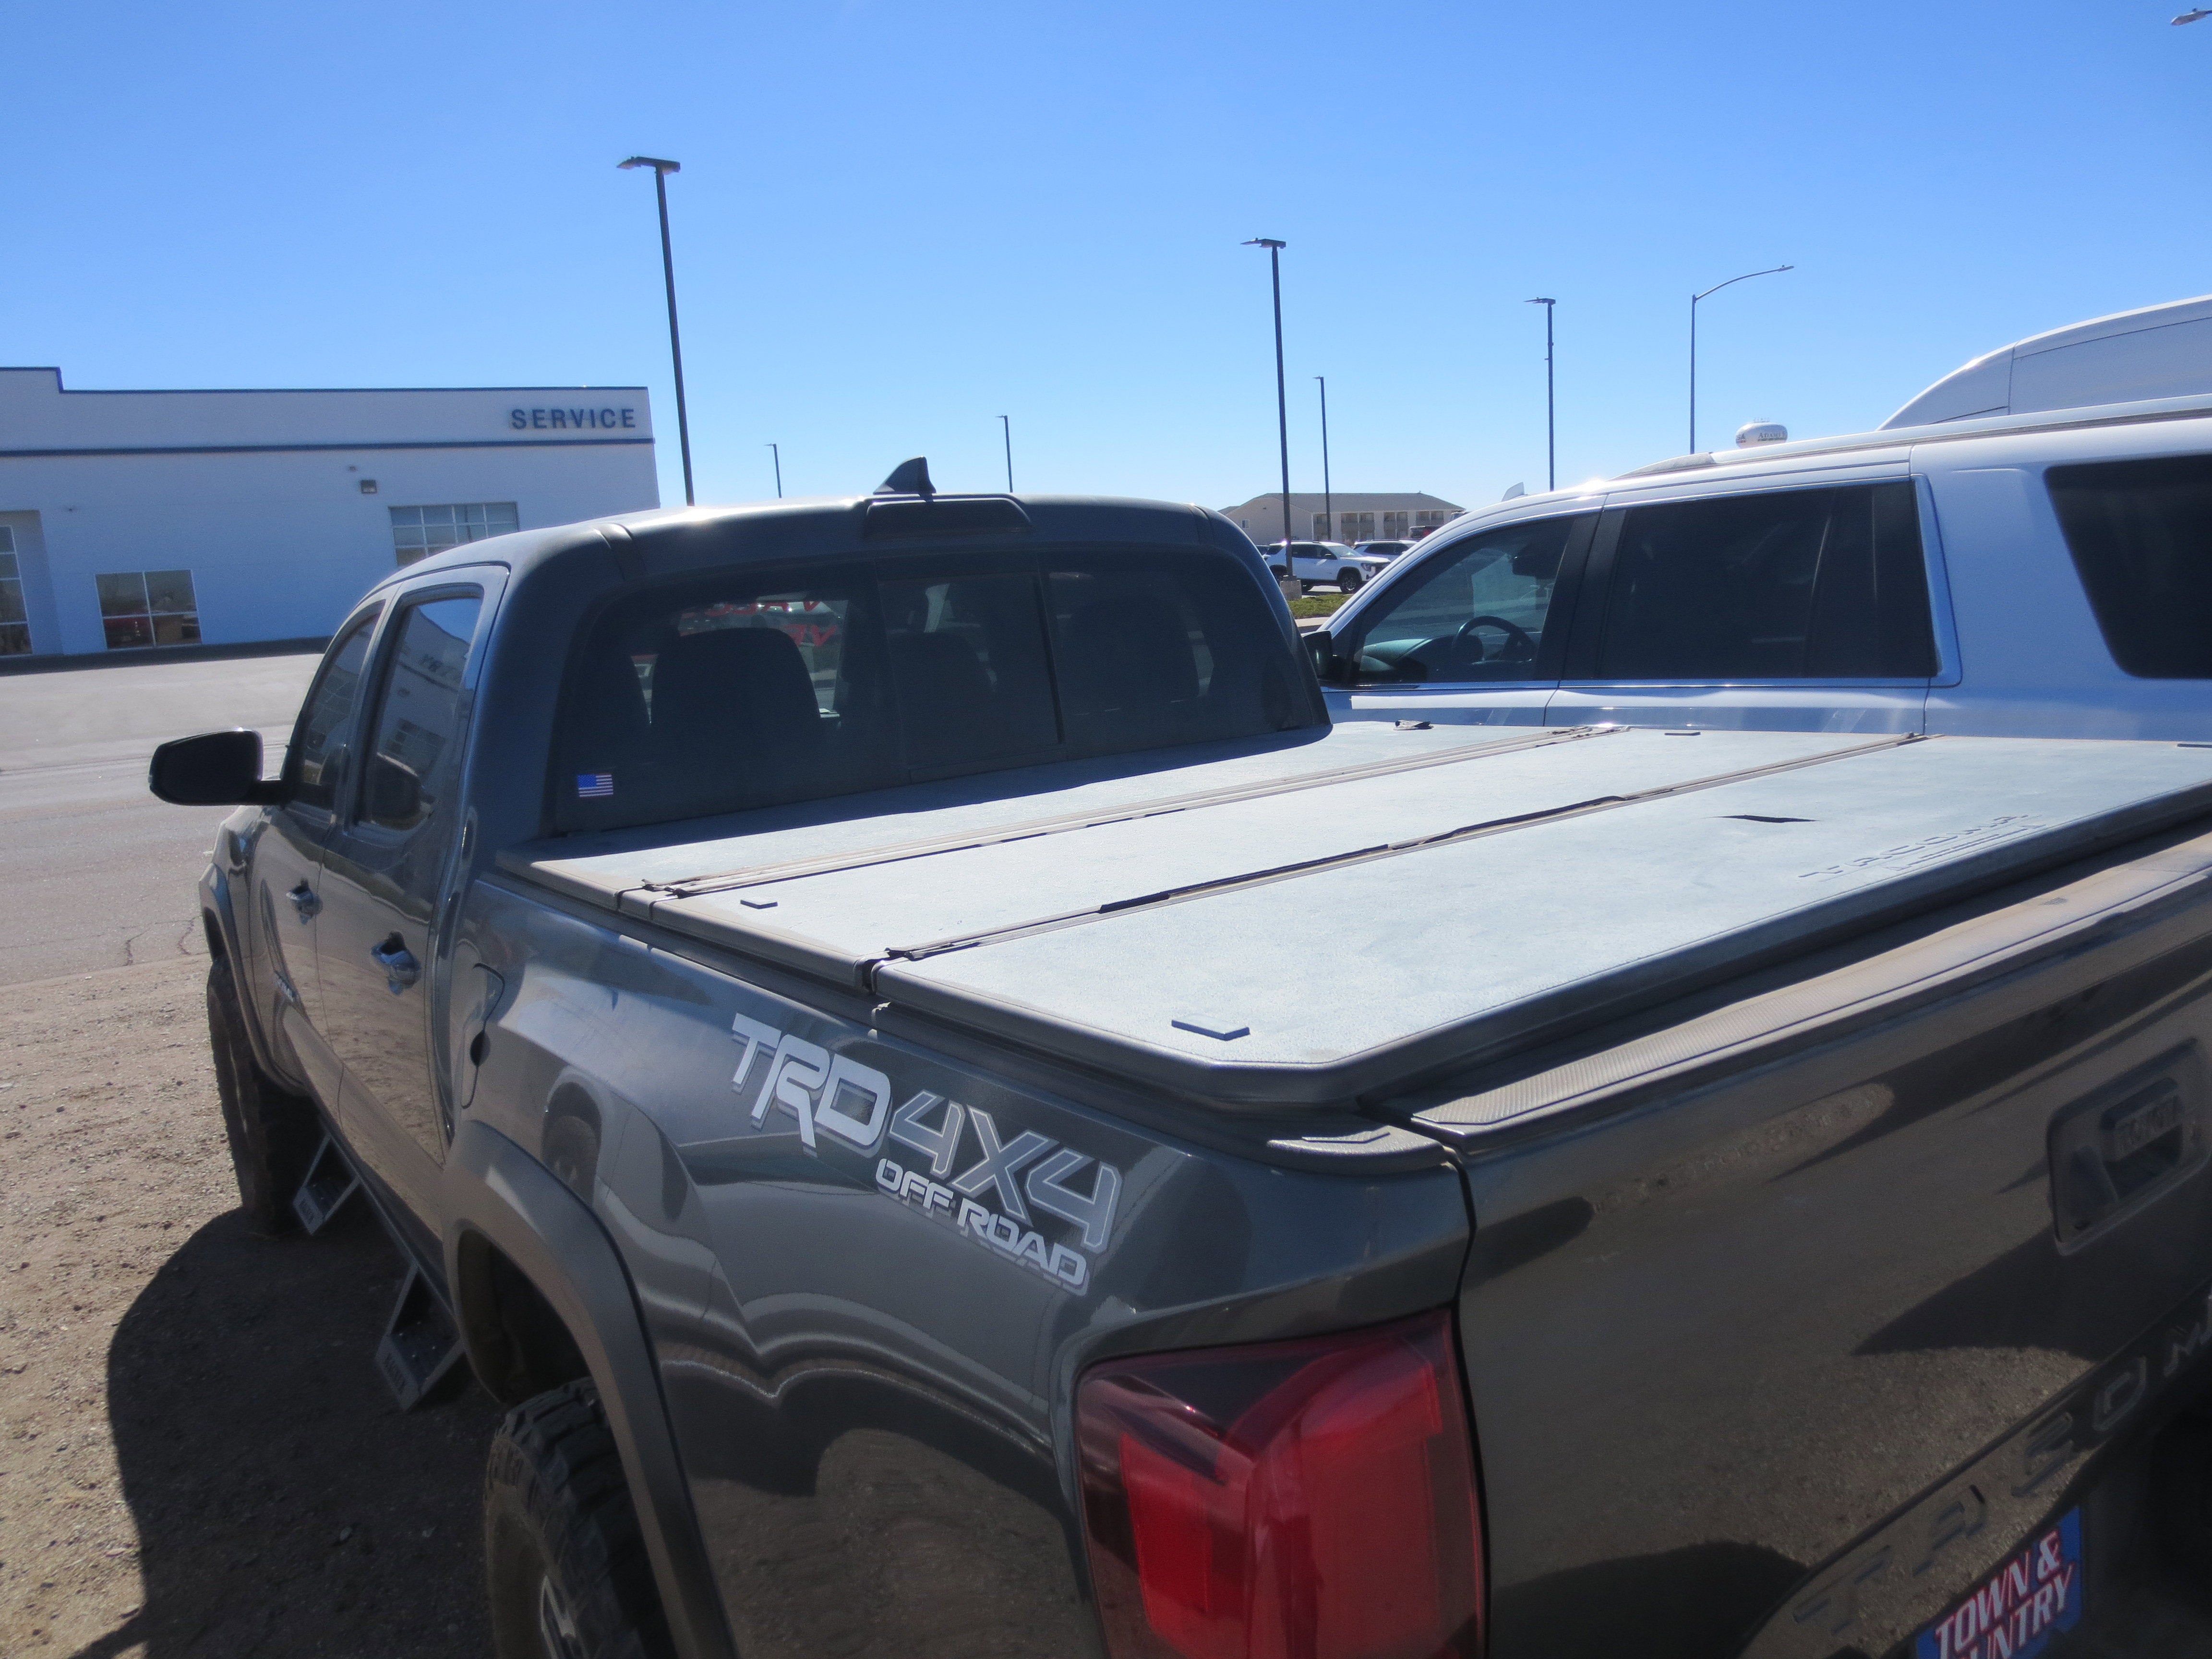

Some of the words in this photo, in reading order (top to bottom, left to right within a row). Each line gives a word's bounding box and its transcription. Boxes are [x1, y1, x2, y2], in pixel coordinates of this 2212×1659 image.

[511, 408, 636, 430] SERVICE
[732, 1012, 892, 1152] TRD
[889, 1089, 1123, 1252] 4X4
[875, 1158, 954, 1212] OFF
[957, 1197, 1090, 1291] ROAD
[1792, 1290, 2212, 1634] TACOM
[1935, 1549, 2032, 1659] TOWN
[2037, 1529, 2062, 1581] &
[1960, 1562, 2075, 1659] NTRY
